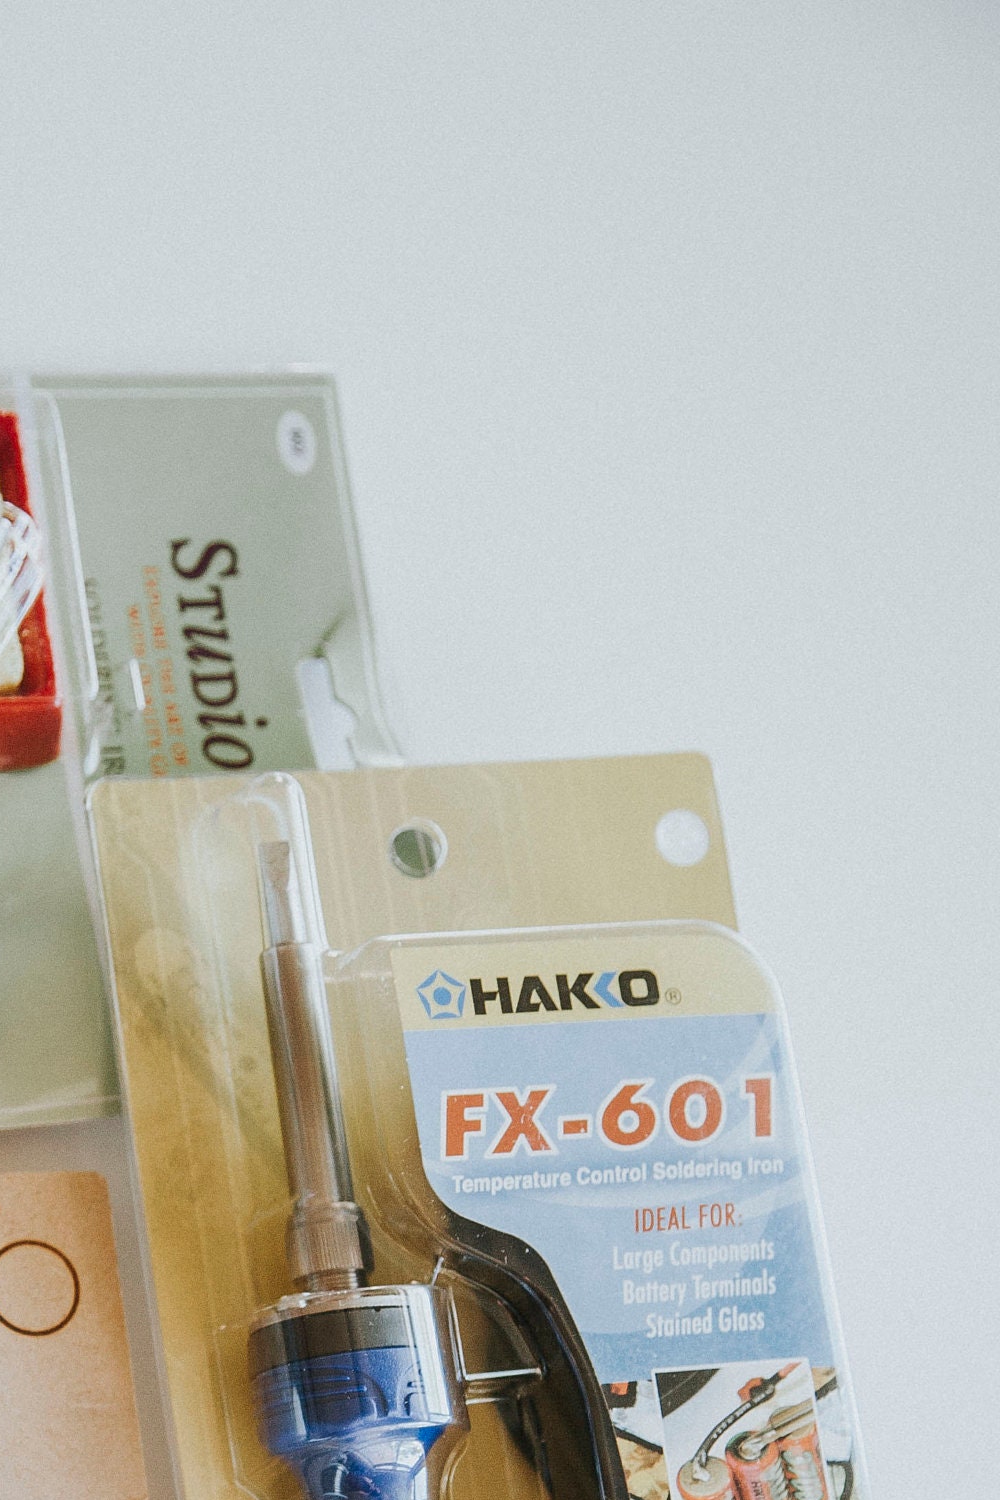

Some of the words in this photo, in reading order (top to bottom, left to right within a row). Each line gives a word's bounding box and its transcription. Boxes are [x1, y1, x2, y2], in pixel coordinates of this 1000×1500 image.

[470, 970, 660, 1015] HAKKO
[443, 1075, 774, 1159] FX-601
[452, 1169, 571, 1195] Temperature
[577, 1162, 646, 1185] Control
[653, 1158, 743, 1183] Soldering
[748, 1156, 784, 1177] Iron
[634, 1206, 691, 1232] IDEAL
[698, 1203, 743, 1228] FOR:
[613, 1245, 664, 1276] Large
[669, 1239, 774, 1271] Components
[622, 1276, 686, 1308] Battery
[694, 1269, 776, 1299] Terminals
[646, 1310, 712, 1338] Stained
[718, 1306, 765, 1332] Glass
